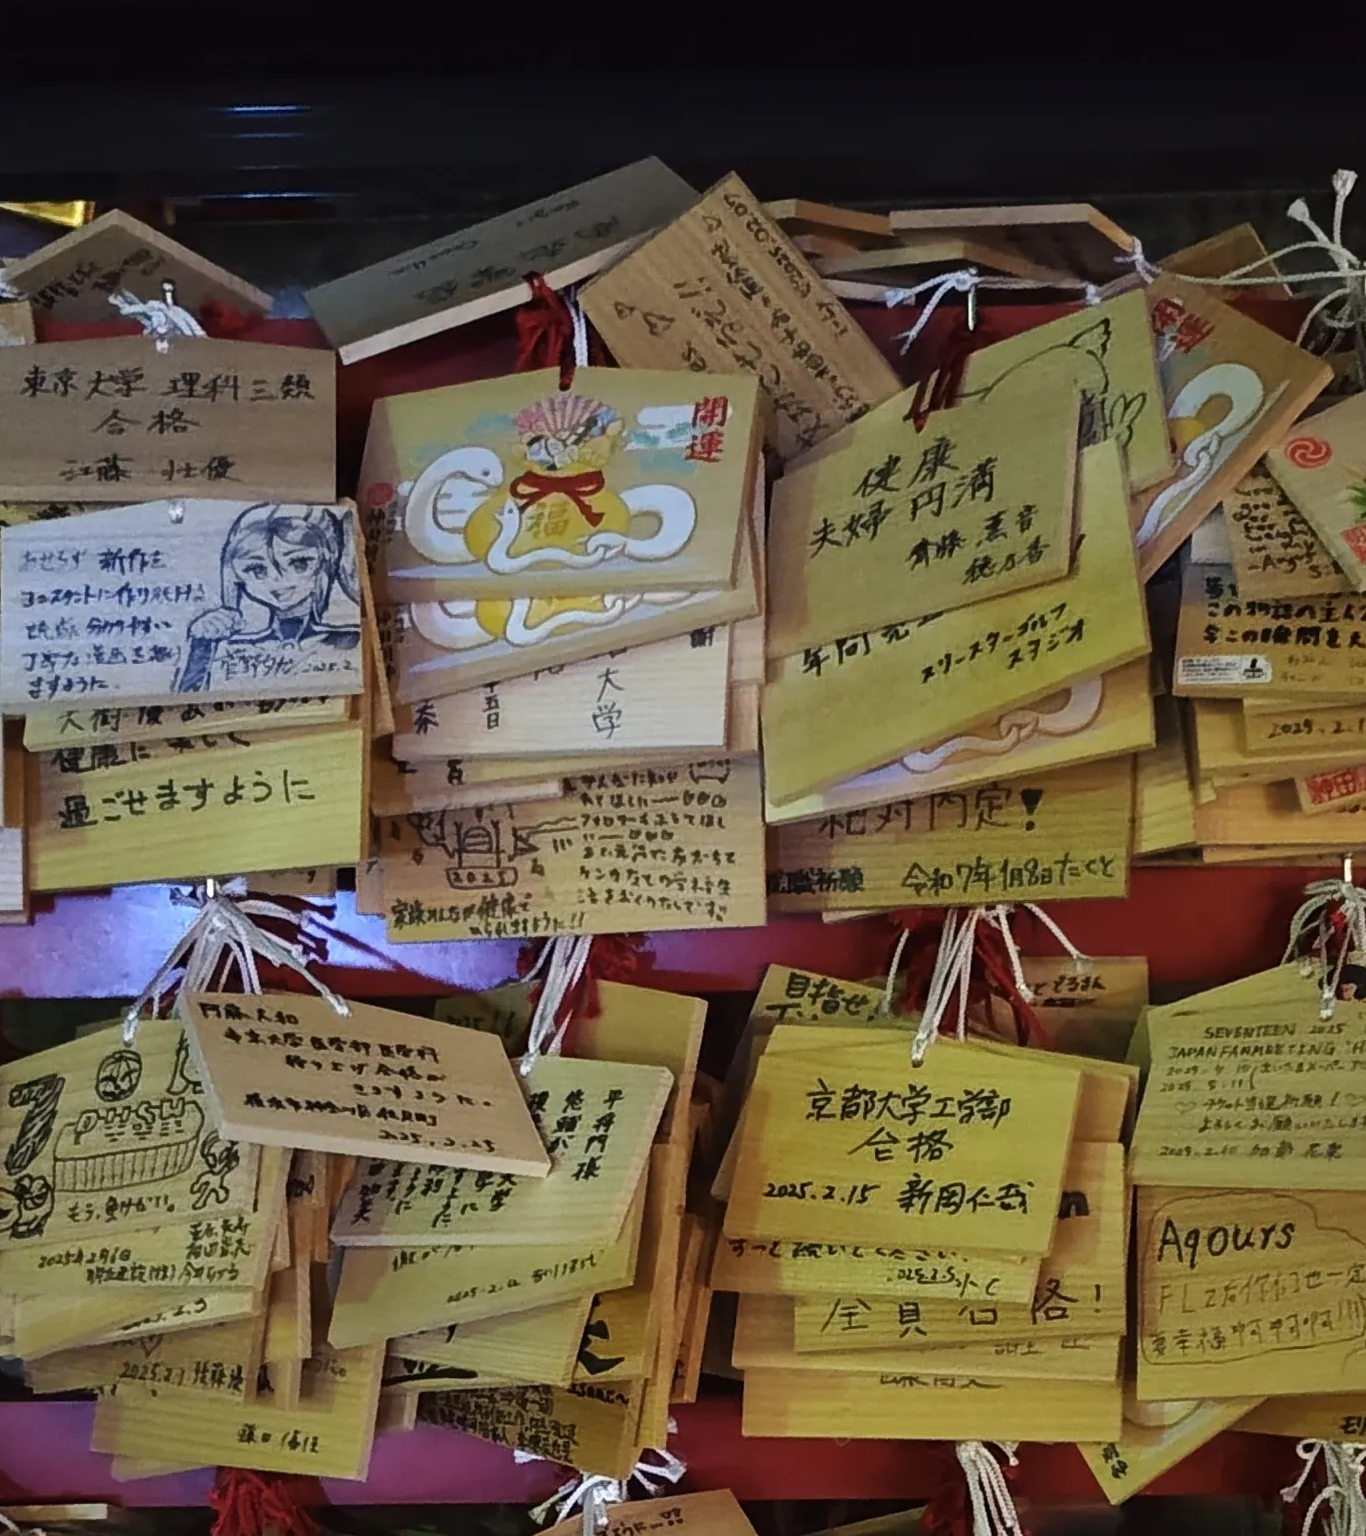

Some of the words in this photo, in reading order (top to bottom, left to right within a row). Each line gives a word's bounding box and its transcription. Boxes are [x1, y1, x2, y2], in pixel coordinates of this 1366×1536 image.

[22, 367, 148, 399] 東京大学
[170, 368, 315, 402] 理科三類
[95, 408, 199, 436] 合格
[684, 396, 729, 463] 開運
[857, 436, 958, 501] 健康
[58, 769, 315, 829] 過ごせますように
[1204, 1023, 1296, 1039] SEVENTEEN
[805, 1078, 1011, 1127] 京都大学工学部
[849, 1128, 954, 1165] 合格
[764, 1182, 881, 1207] 2025.2.15
